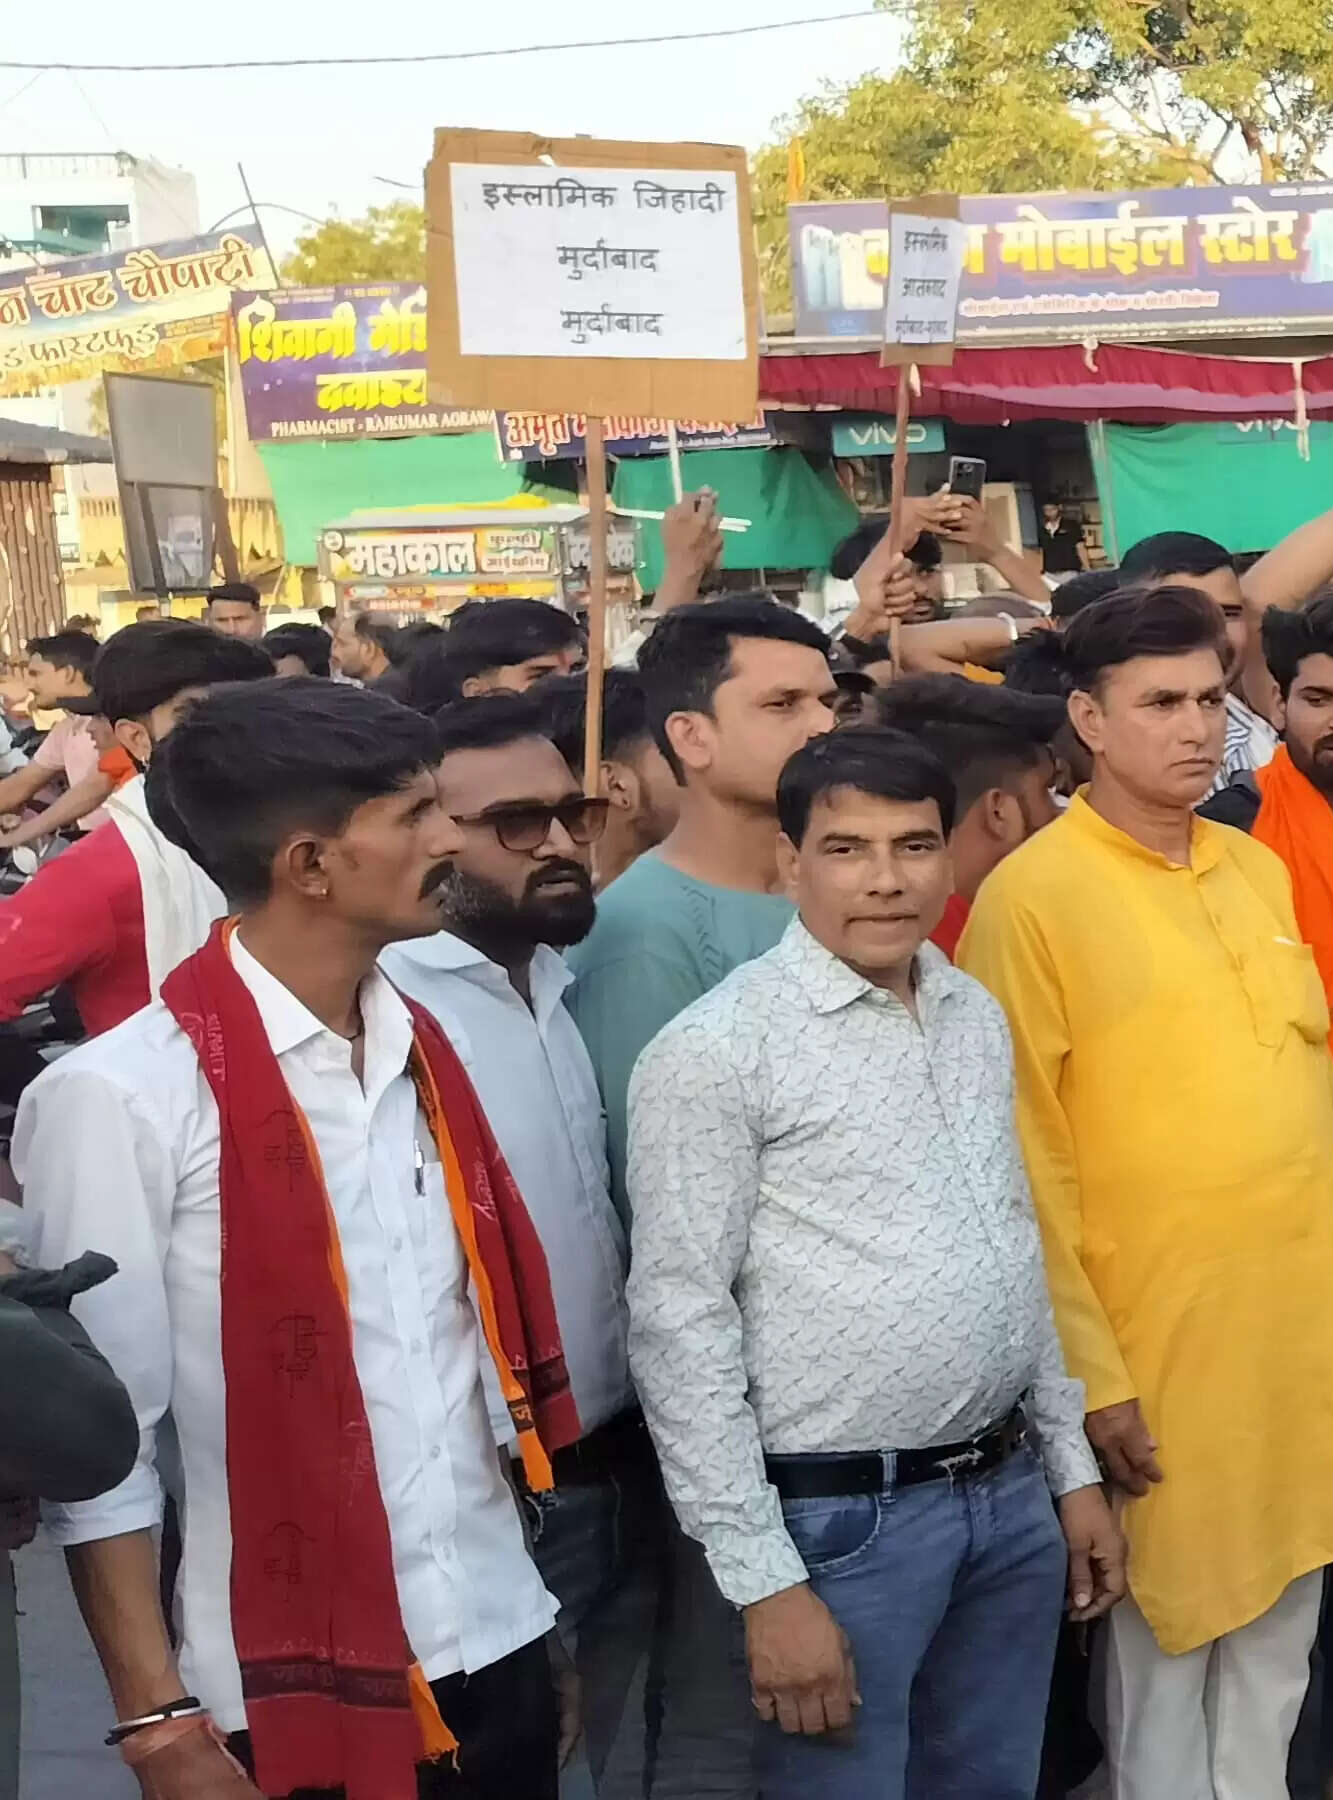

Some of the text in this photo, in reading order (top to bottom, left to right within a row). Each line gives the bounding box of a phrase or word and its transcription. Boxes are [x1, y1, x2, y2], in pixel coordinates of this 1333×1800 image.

[482, 177, 727, 214] इस्लामिक जिहादी
[997, 200, 1188, 275] मोबाईल
[1197, 196, 1299, 264] स्टोर
[556, 238, 660, 280] मुर्दाबाद
[238, 295, 358, 365] शिवानी
[560, 303, 664, 344] मुर्दाबाद
[271, 418, 357, 438] PHARMACIST
[441, 408, 498, 428] AGRAWA
[347, 533, 477, 578] महाकाल
